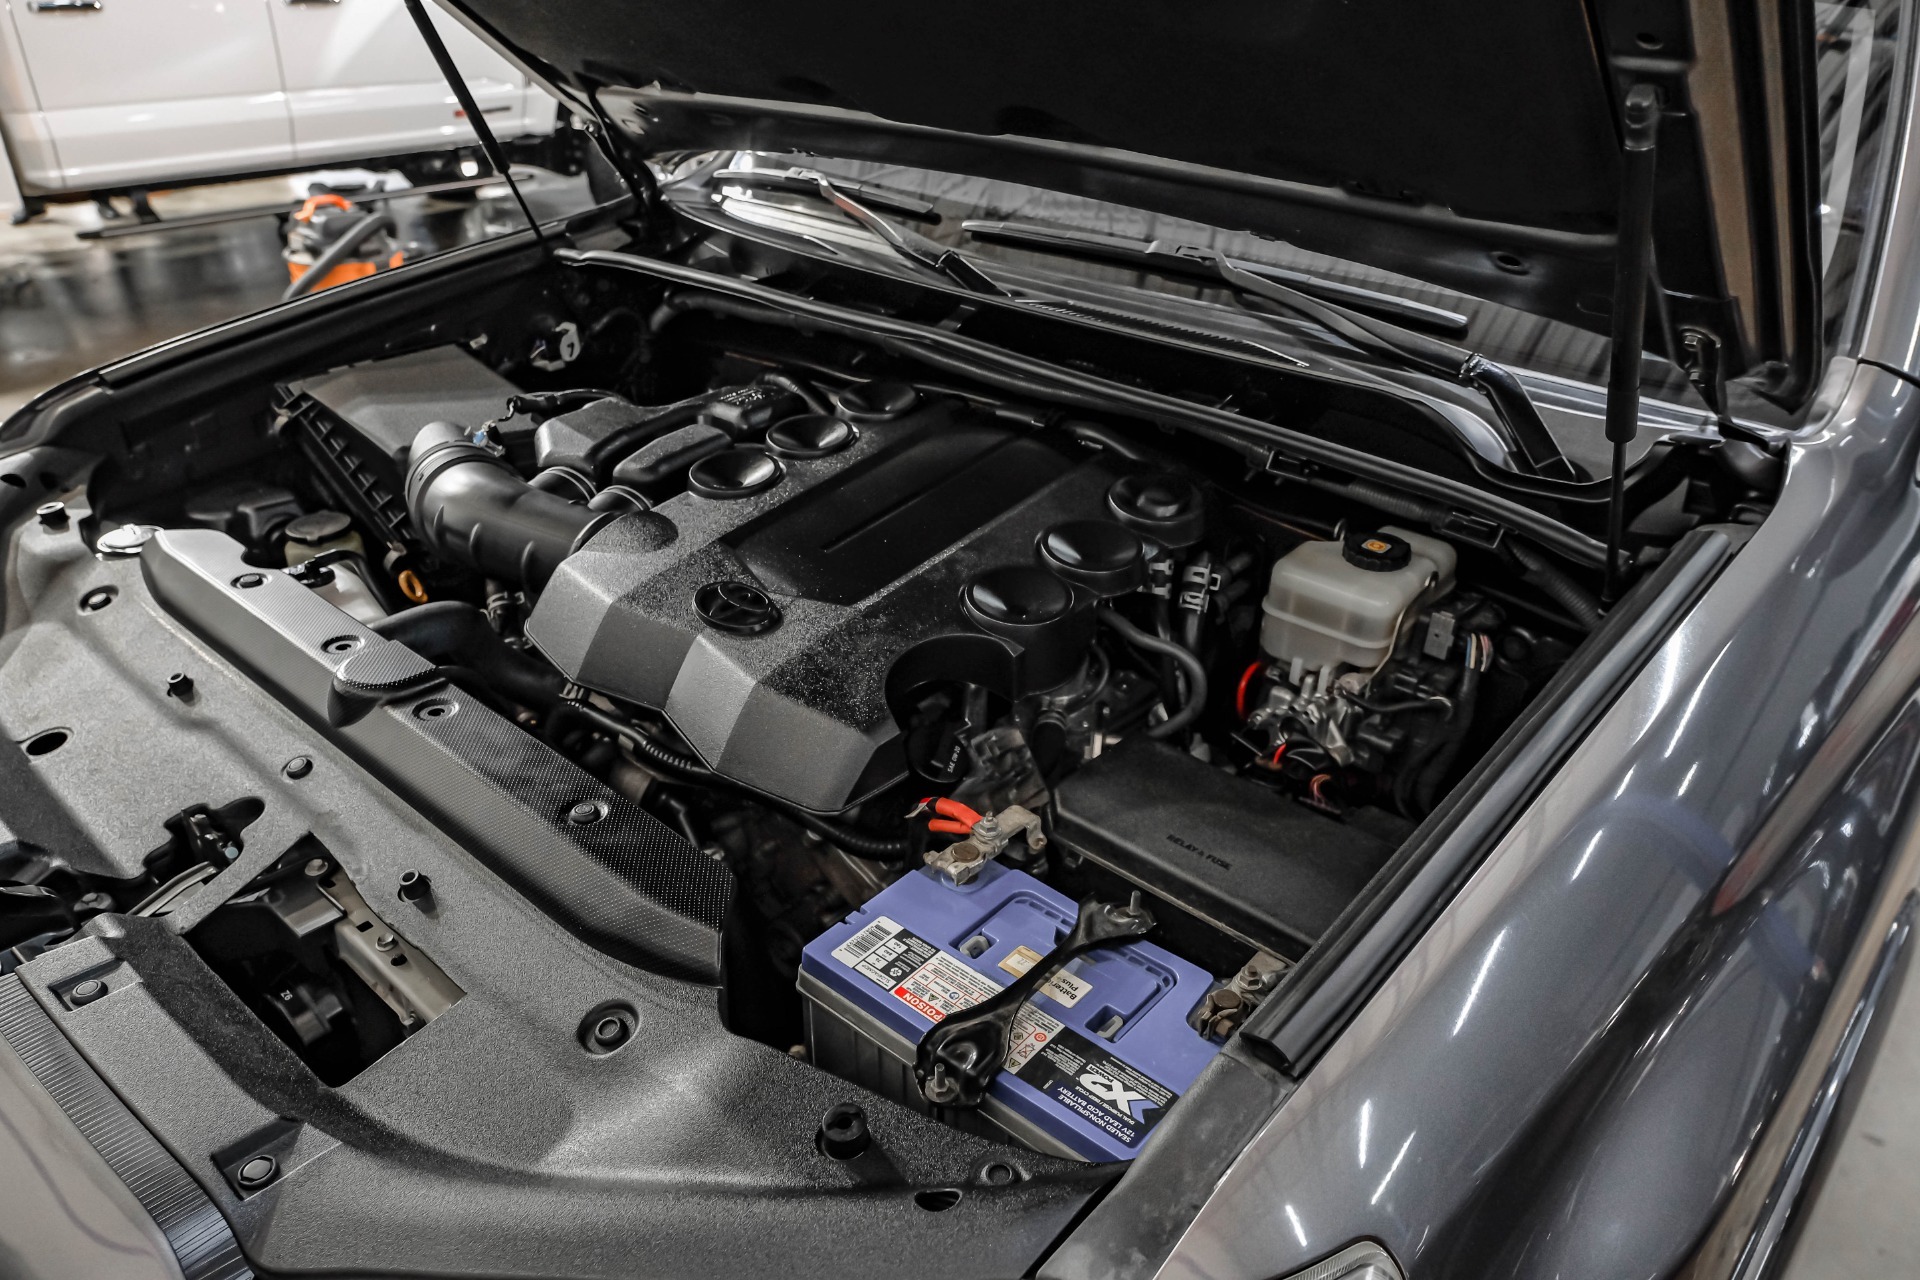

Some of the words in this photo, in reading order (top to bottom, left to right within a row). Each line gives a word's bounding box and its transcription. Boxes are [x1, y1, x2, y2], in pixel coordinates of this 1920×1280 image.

[947, 761, 955, 773] SAE
[1206, 854, 1233, 870] FUSE
[1060, 978, 1079, 991] Plus
[903, 993, 943, 1021] POISON
[1088, 1066, 1114, 1082] POWER
[1057, 1086, 1087, 1105] BATTERY
[1075, 1086, 1089, 1095] CYCLE
[1079, 1064, 1147, 1115] X2
[1058, 1094, 1107, 1127] NON-SPILLABLE
[1086, 1104, 1104, 1116] ACID
[1104, 1115, 1122, 1128] LEAD
[1121, 1115, 1135, 1125] DUAL
[1105, 1124, 1132, 1142] SEALED
[1121, 1127, 1135, 1137] 12V
